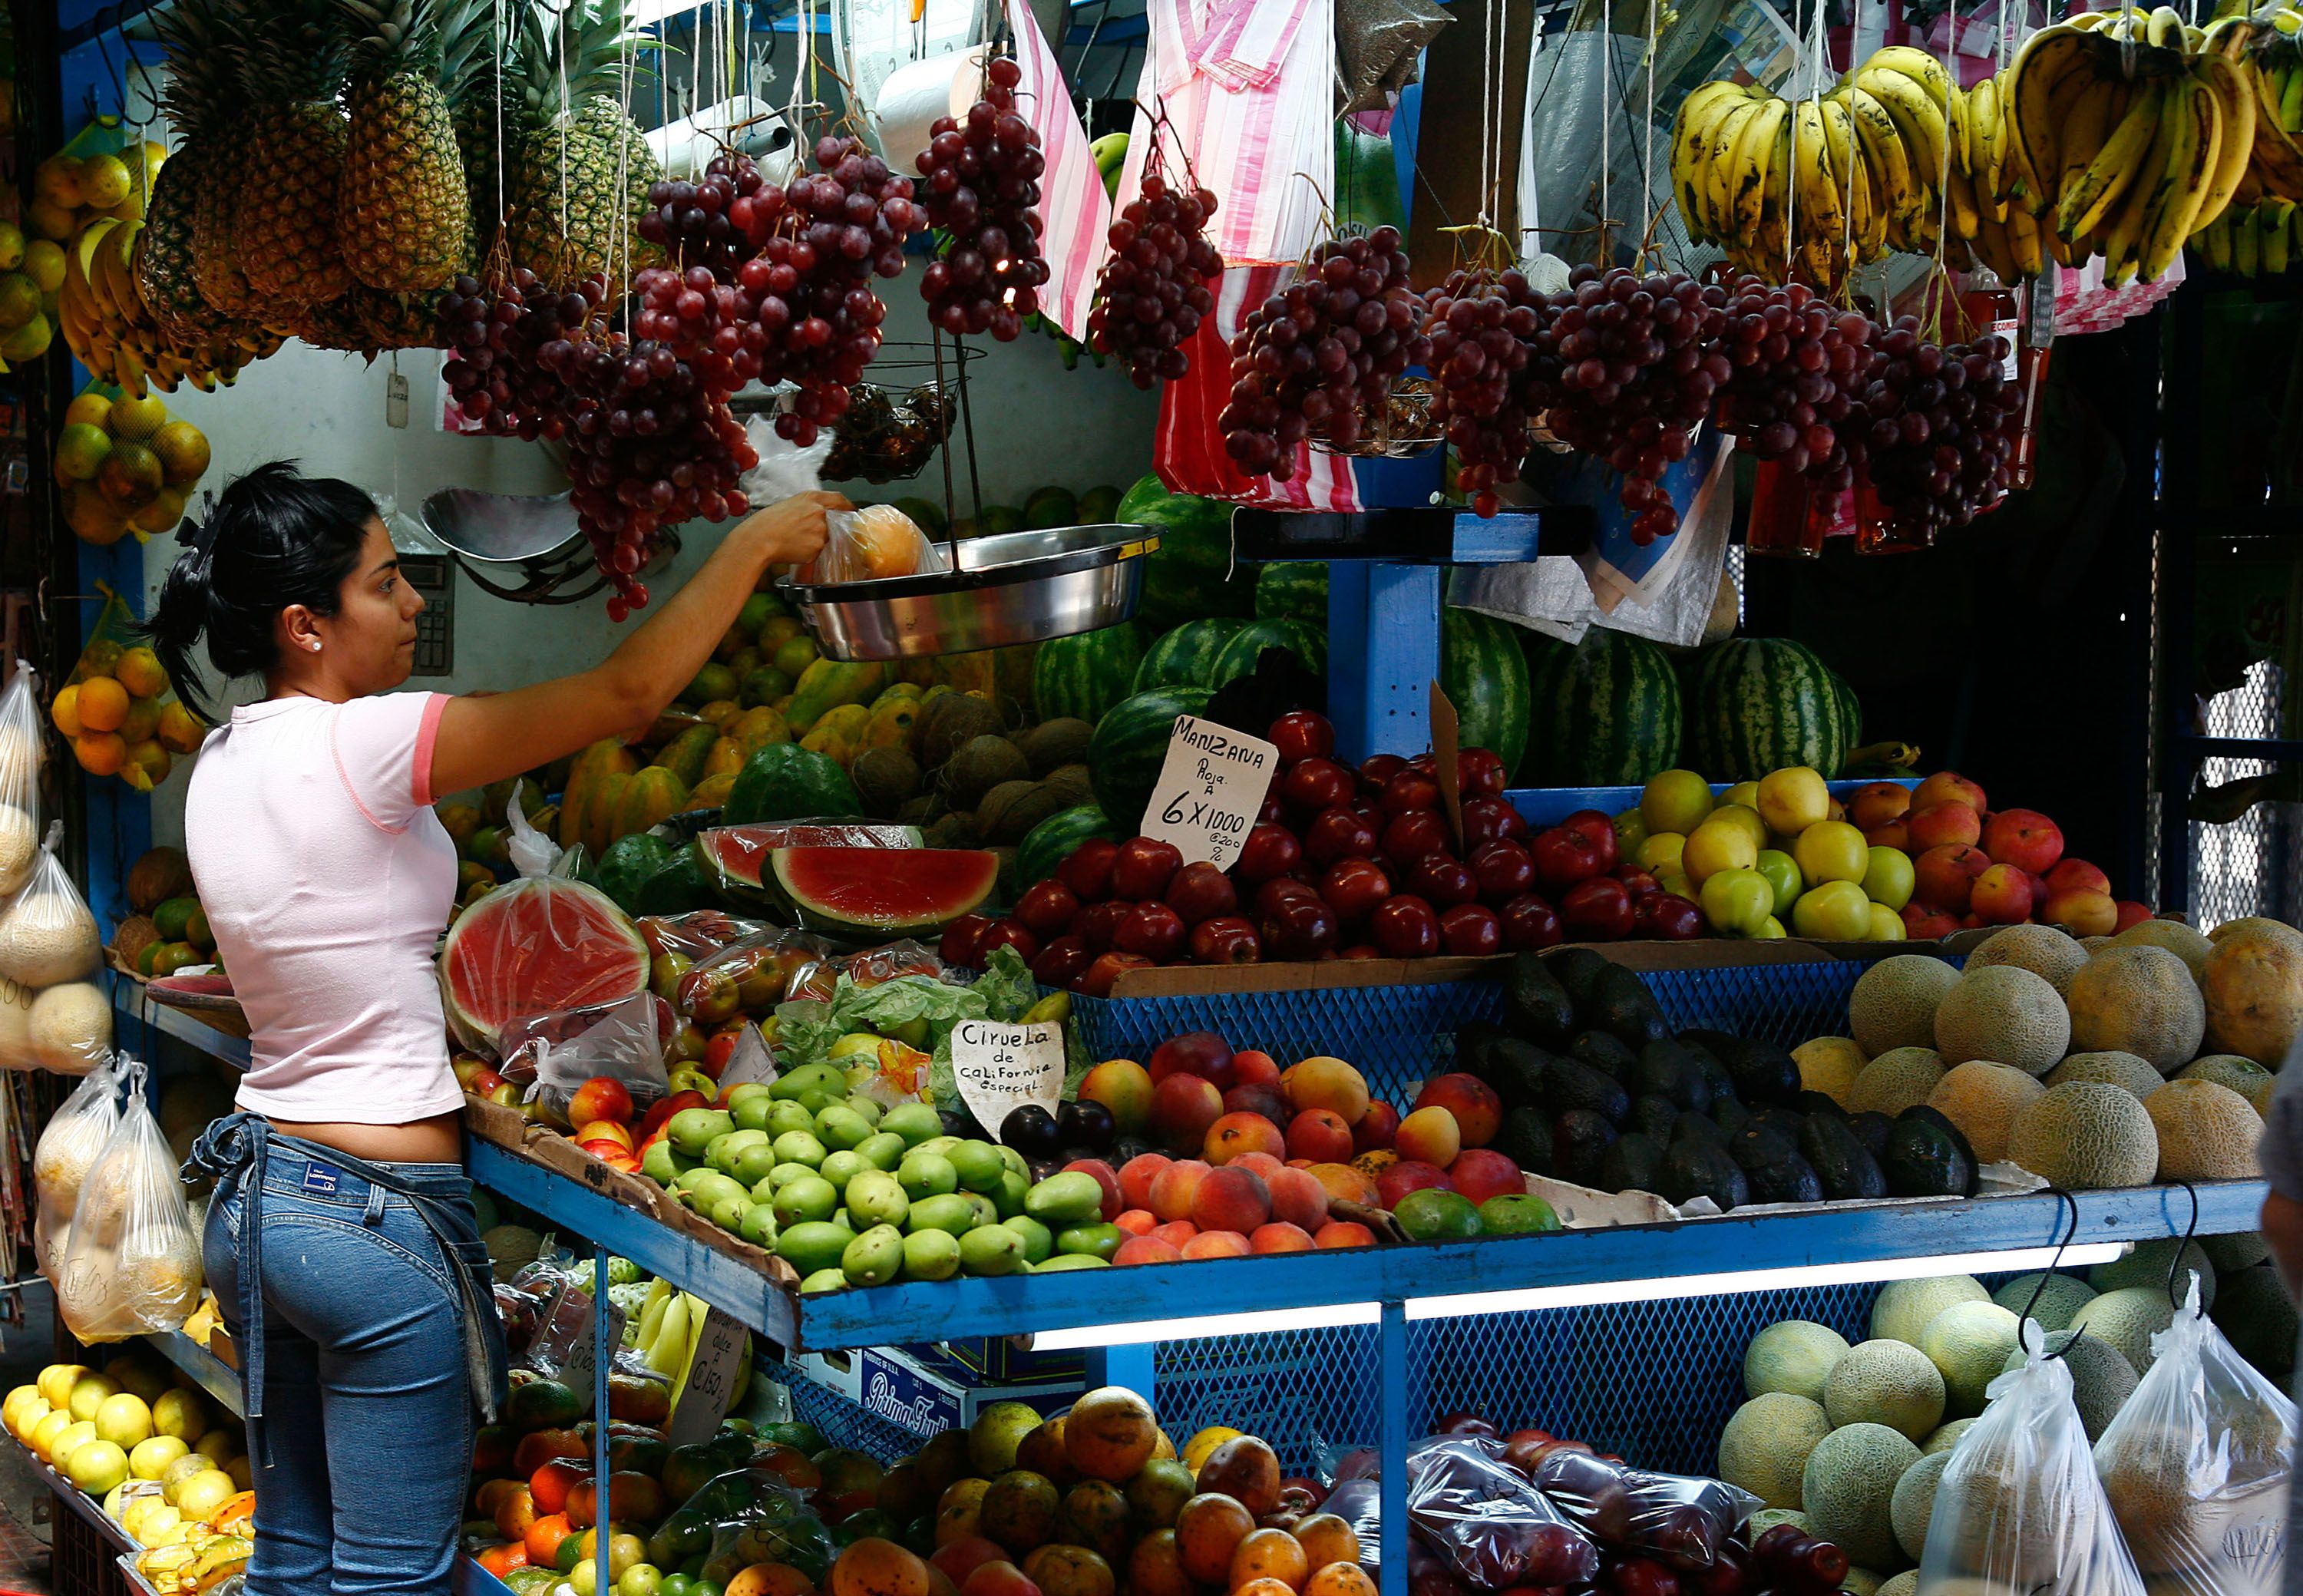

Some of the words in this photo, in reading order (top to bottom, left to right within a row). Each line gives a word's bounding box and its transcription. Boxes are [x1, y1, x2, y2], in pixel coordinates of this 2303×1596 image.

[1171, 716, 1264, 769] MANZANA
[1203, 785, 1214, 795] A
[993, 1049, 1014, 1063] de
